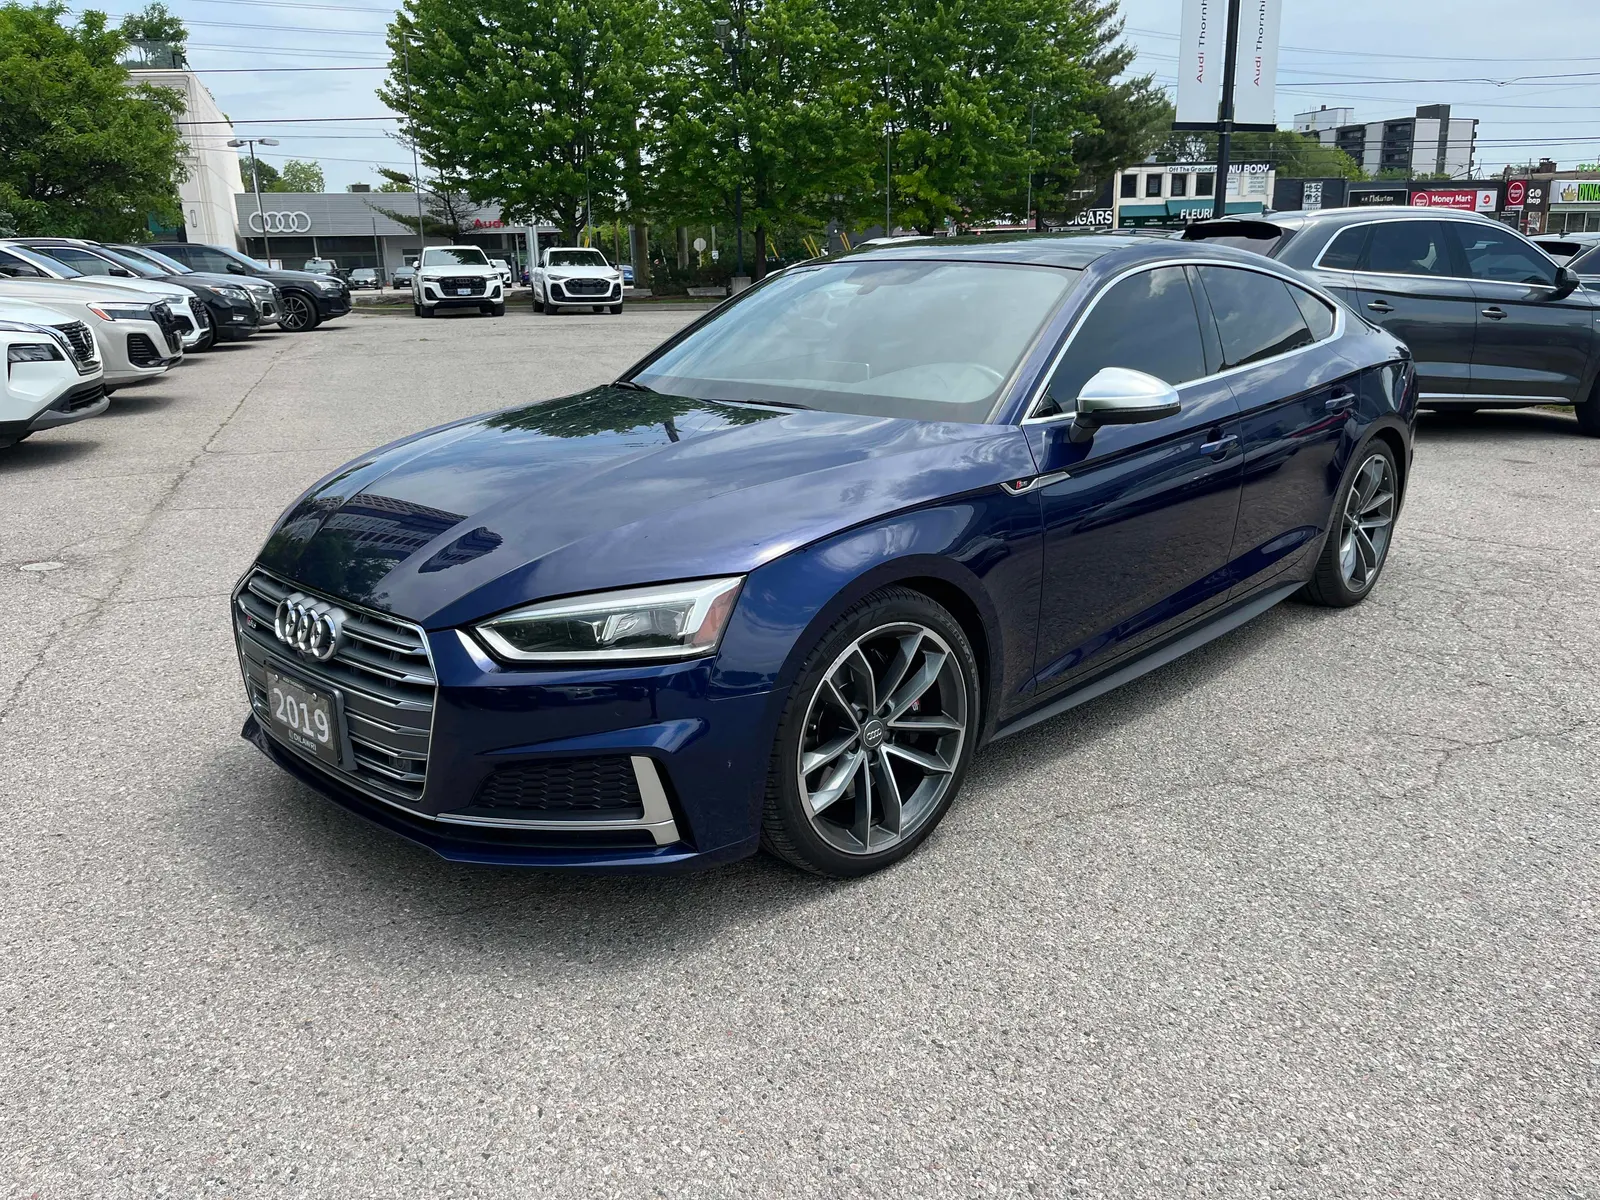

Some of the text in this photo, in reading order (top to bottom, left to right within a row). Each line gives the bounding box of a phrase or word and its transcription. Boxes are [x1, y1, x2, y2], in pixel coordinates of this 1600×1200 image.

[1196, 52, 1204, 83] Audi
[1253, 56, 1262, 87] Audi
[1243, 164, 1270, 173] BODY
[1431, 194, 1471, 204] Money Mart
[273, 687, 329, 743] 2019
